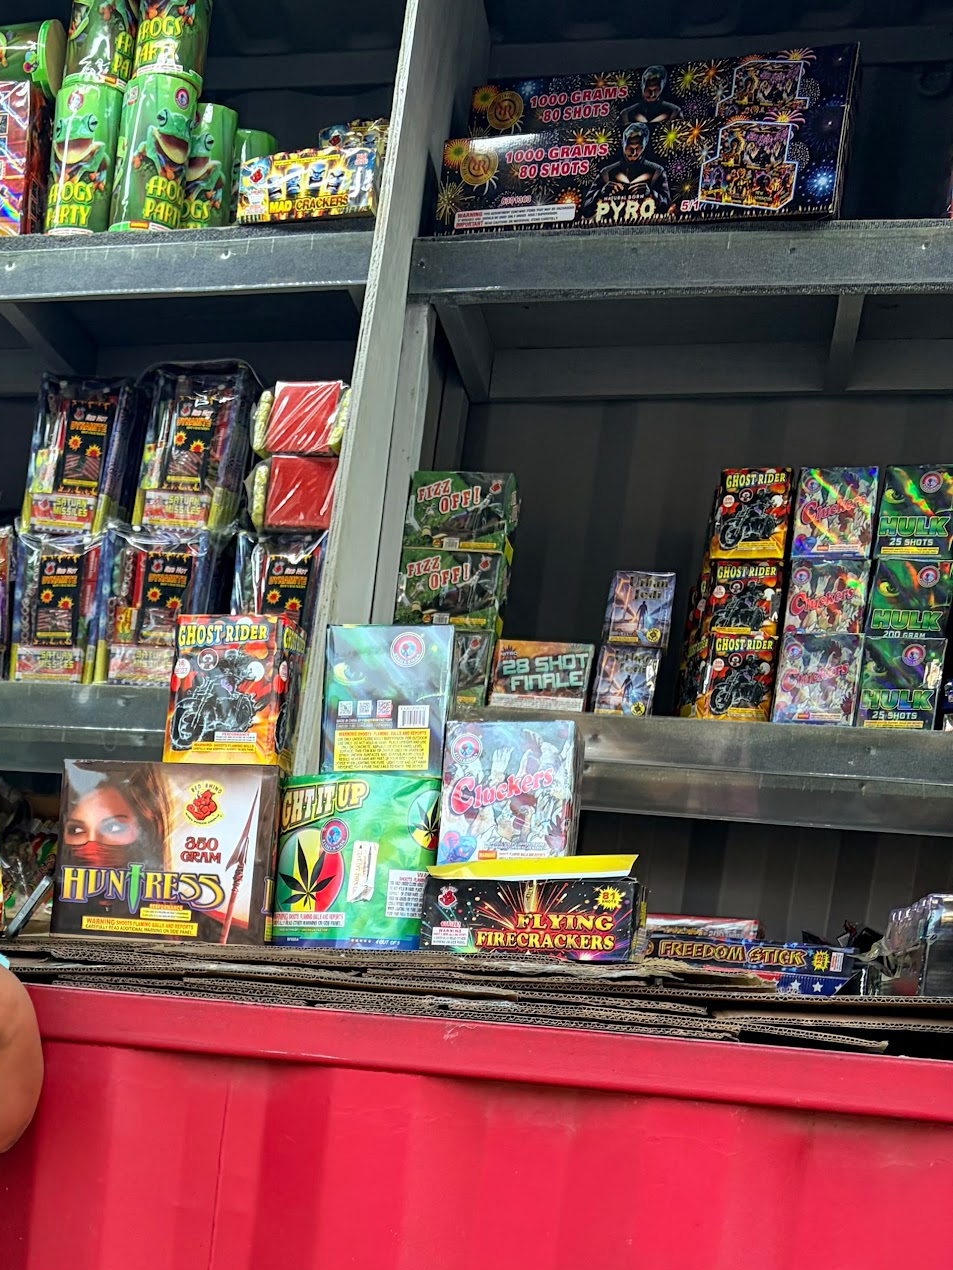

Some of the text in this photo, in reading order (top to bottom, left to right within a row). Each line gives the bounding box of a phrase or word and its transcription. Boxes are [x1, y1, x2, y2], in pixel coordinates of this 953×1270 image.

[530, 86, 629, 108] 1000 GRAMS
[542, 102, 610, 123] 80 SHOTS
[505, 143, 610, 164] 1000 GRAMS
[518, 160, 589, 180] 80 SHOTS
[146, 175, 185, 203] FRO
[144, 197, 182, 229] PART
[180, 200, 212, 221] OGS
[269, 195, 349, 214] MAD CRACKERS
[596, 201, 655, 221] PYRO
[70, 421, 107, 432] DYNAMITE
[176, 417, 212, 428] DYNAMITE
[417, 478, 451, 502] FIZZ
[726, 473, 786, 488] GHOST RIDER
[55, 497, 88, 508] SATURN
[165, 503, 201, 514] MISSILES
[168, 495, 200, 504] SATURN
[439, 486, 481, 514] OFF!
[53, 506, 88, 517] MISSILES
[878, 516, 950, 537] HULK
[889, 538, 903, 546] 25
[406, 555, 441, 578] FIZZ
[429, 562, 471, 590] OFF!
[717, 566, 777, 579] GHOST RIDER
[41, 575, 77, 585] DYNAMITE
[148, 574, 187, 584] DYNAMITE
[268, 576, 307, 586] DYNAMITE
[870, 608, 943, 631] HULK
[178, 624, 224, 648] GHOST
[224, 624, 269, 643] RIDER
[883, 630, 901, 638] 200
[715, 638, 745, 652] GHOST
[746, 639, 773, 650] RIDER
[502, 653, 588, 675] 28 SHOT
[510, 671, 584, 691] FINALE
[860, 689, 935, 710] HULK
[872, 711, 918, 720] 25 SHOTS
[450, 768, 554, 815] Cluckers
[281, 782, 368, 828] GHT IT UP
[180, 851, 222, 864] GRAM
[59, 863, 225, 913] HUNTRESS
[602, 891, 616, 900] 81
[515, 912, 615, 932] FLYING
[476, 930, 615, 951] FIRECRACKERS
[659, 940, 808, 967] FREEDOM STICK
